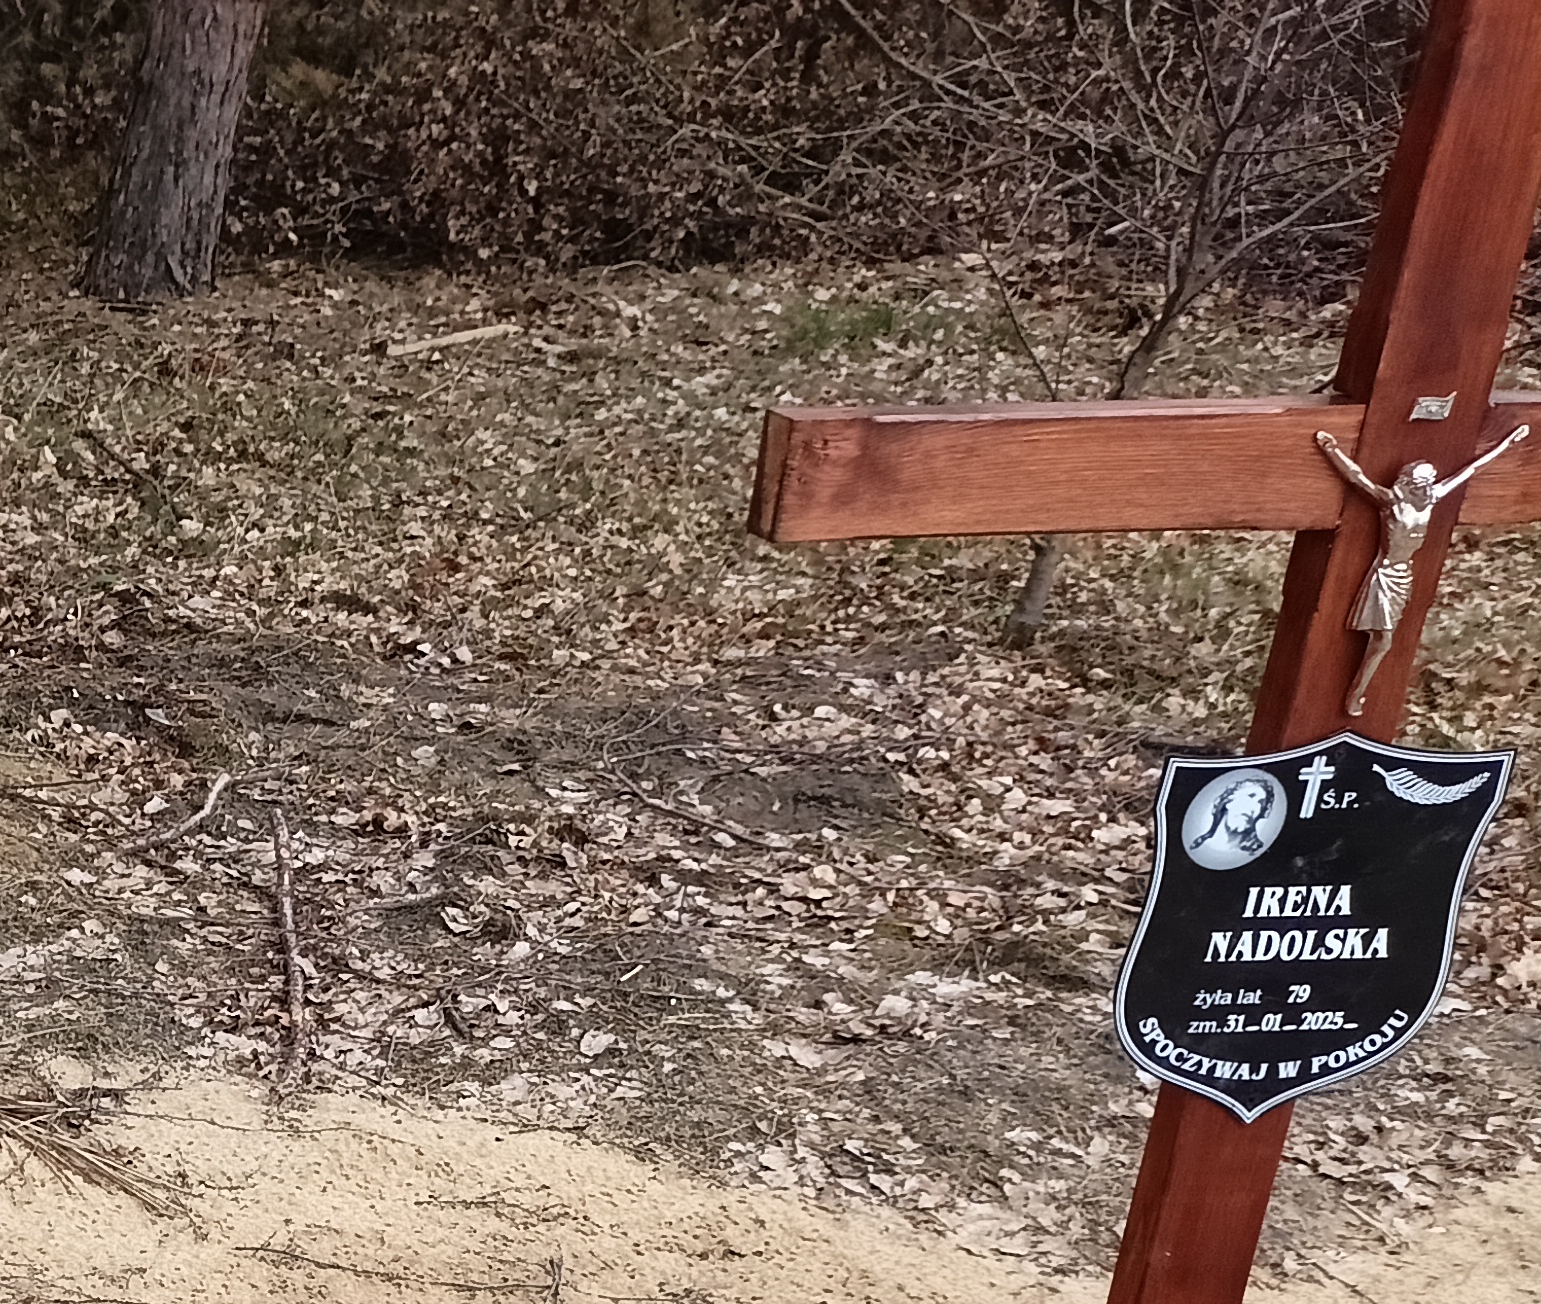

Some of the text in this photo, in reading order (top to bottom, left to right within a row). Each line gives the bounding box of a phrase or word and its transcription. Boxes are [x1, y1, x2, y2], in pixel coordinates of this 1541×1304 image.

[1320, 789, 1359, 810] Ś.P.
[1241, 885, 1352, 918] IRENA
[1203, 928, 1389, 962] NADOLSKA
[1192, 984, 1311, 1009] żyła lat 79
[1139, 1009, 1409, 1081] SPOCZYWAJ W POKOJU
